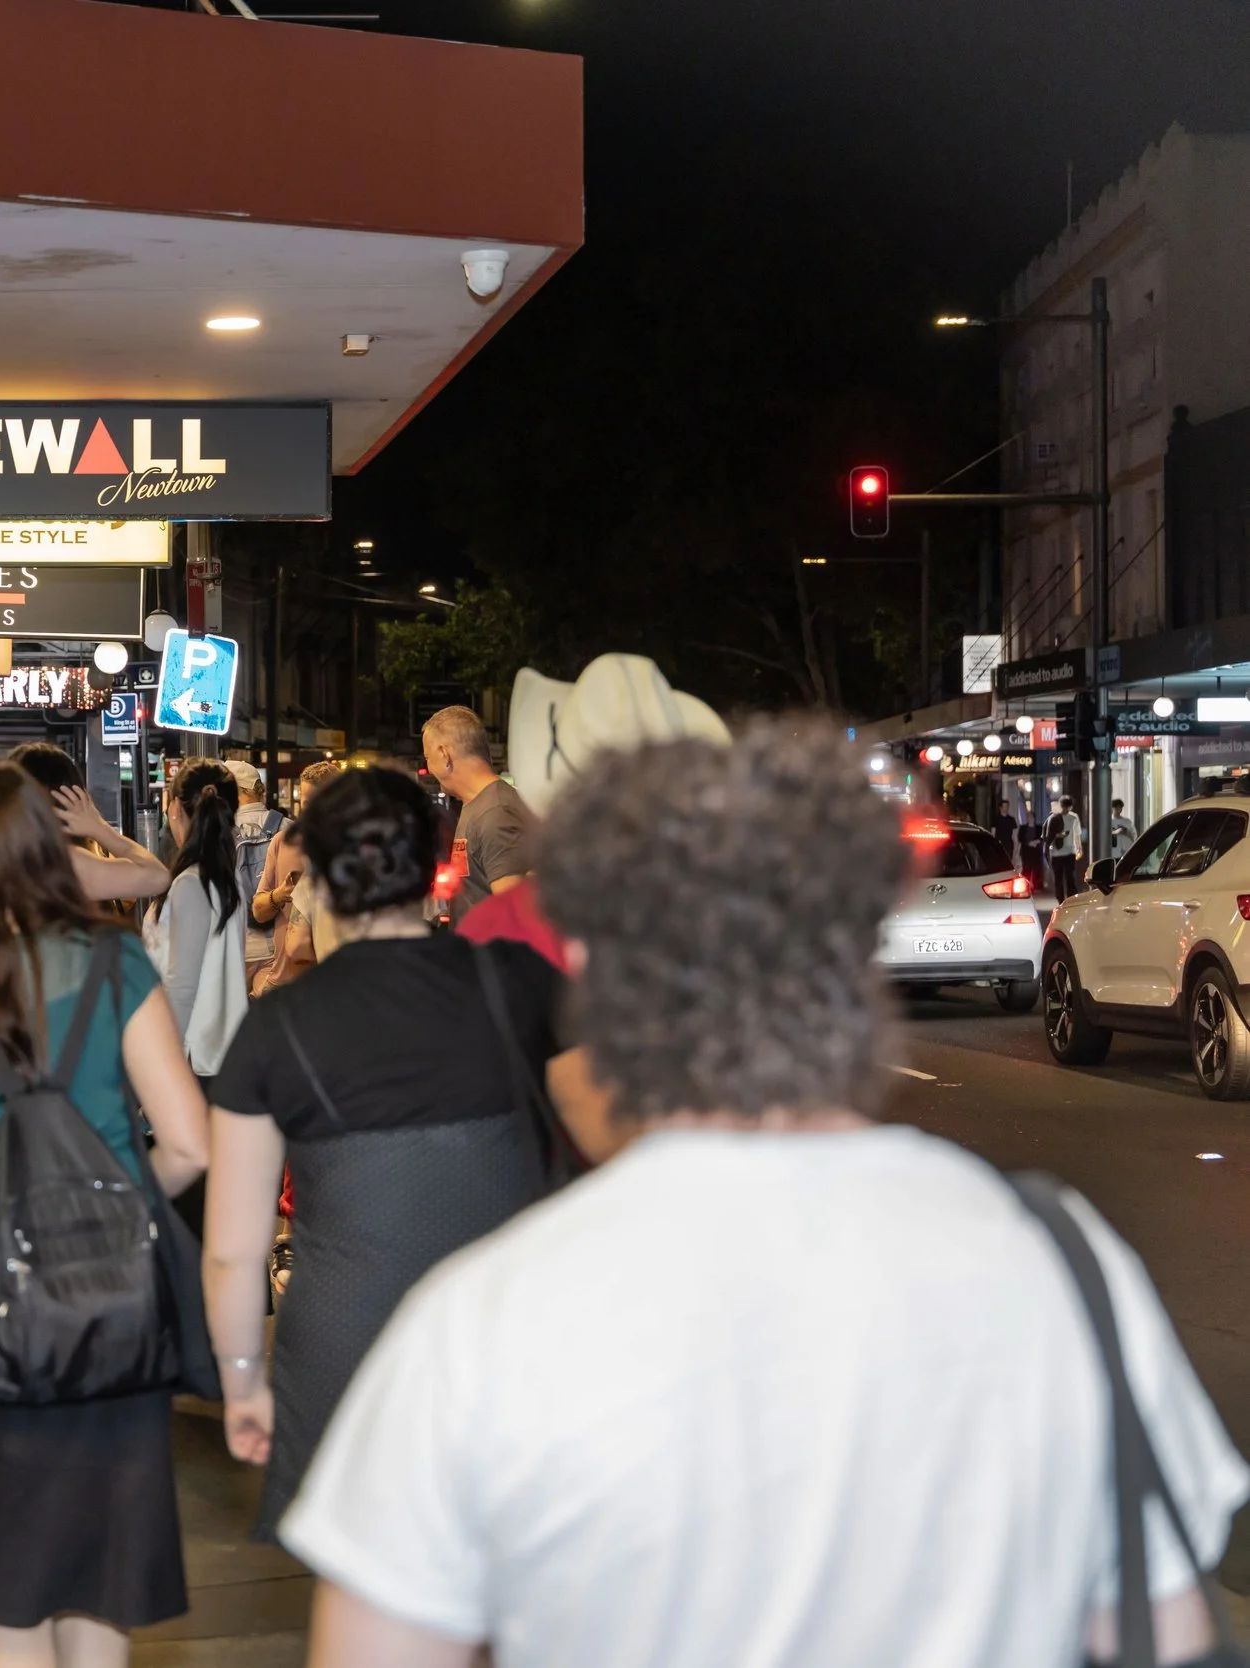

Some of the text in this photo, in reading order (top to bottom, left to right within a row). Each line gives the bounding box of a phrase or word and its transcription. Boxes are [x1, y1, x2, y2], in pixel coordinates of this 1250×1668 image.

[97, 466, 216, 507] Newtown
[19, 530, 88, 544] STYLE
[181, 640, 217, 679] P
[1009, 663, 1074, 687] addicted to audio
[1118, 711, 1198, 721] addited
[1139, 721, 1190, 731] audio
